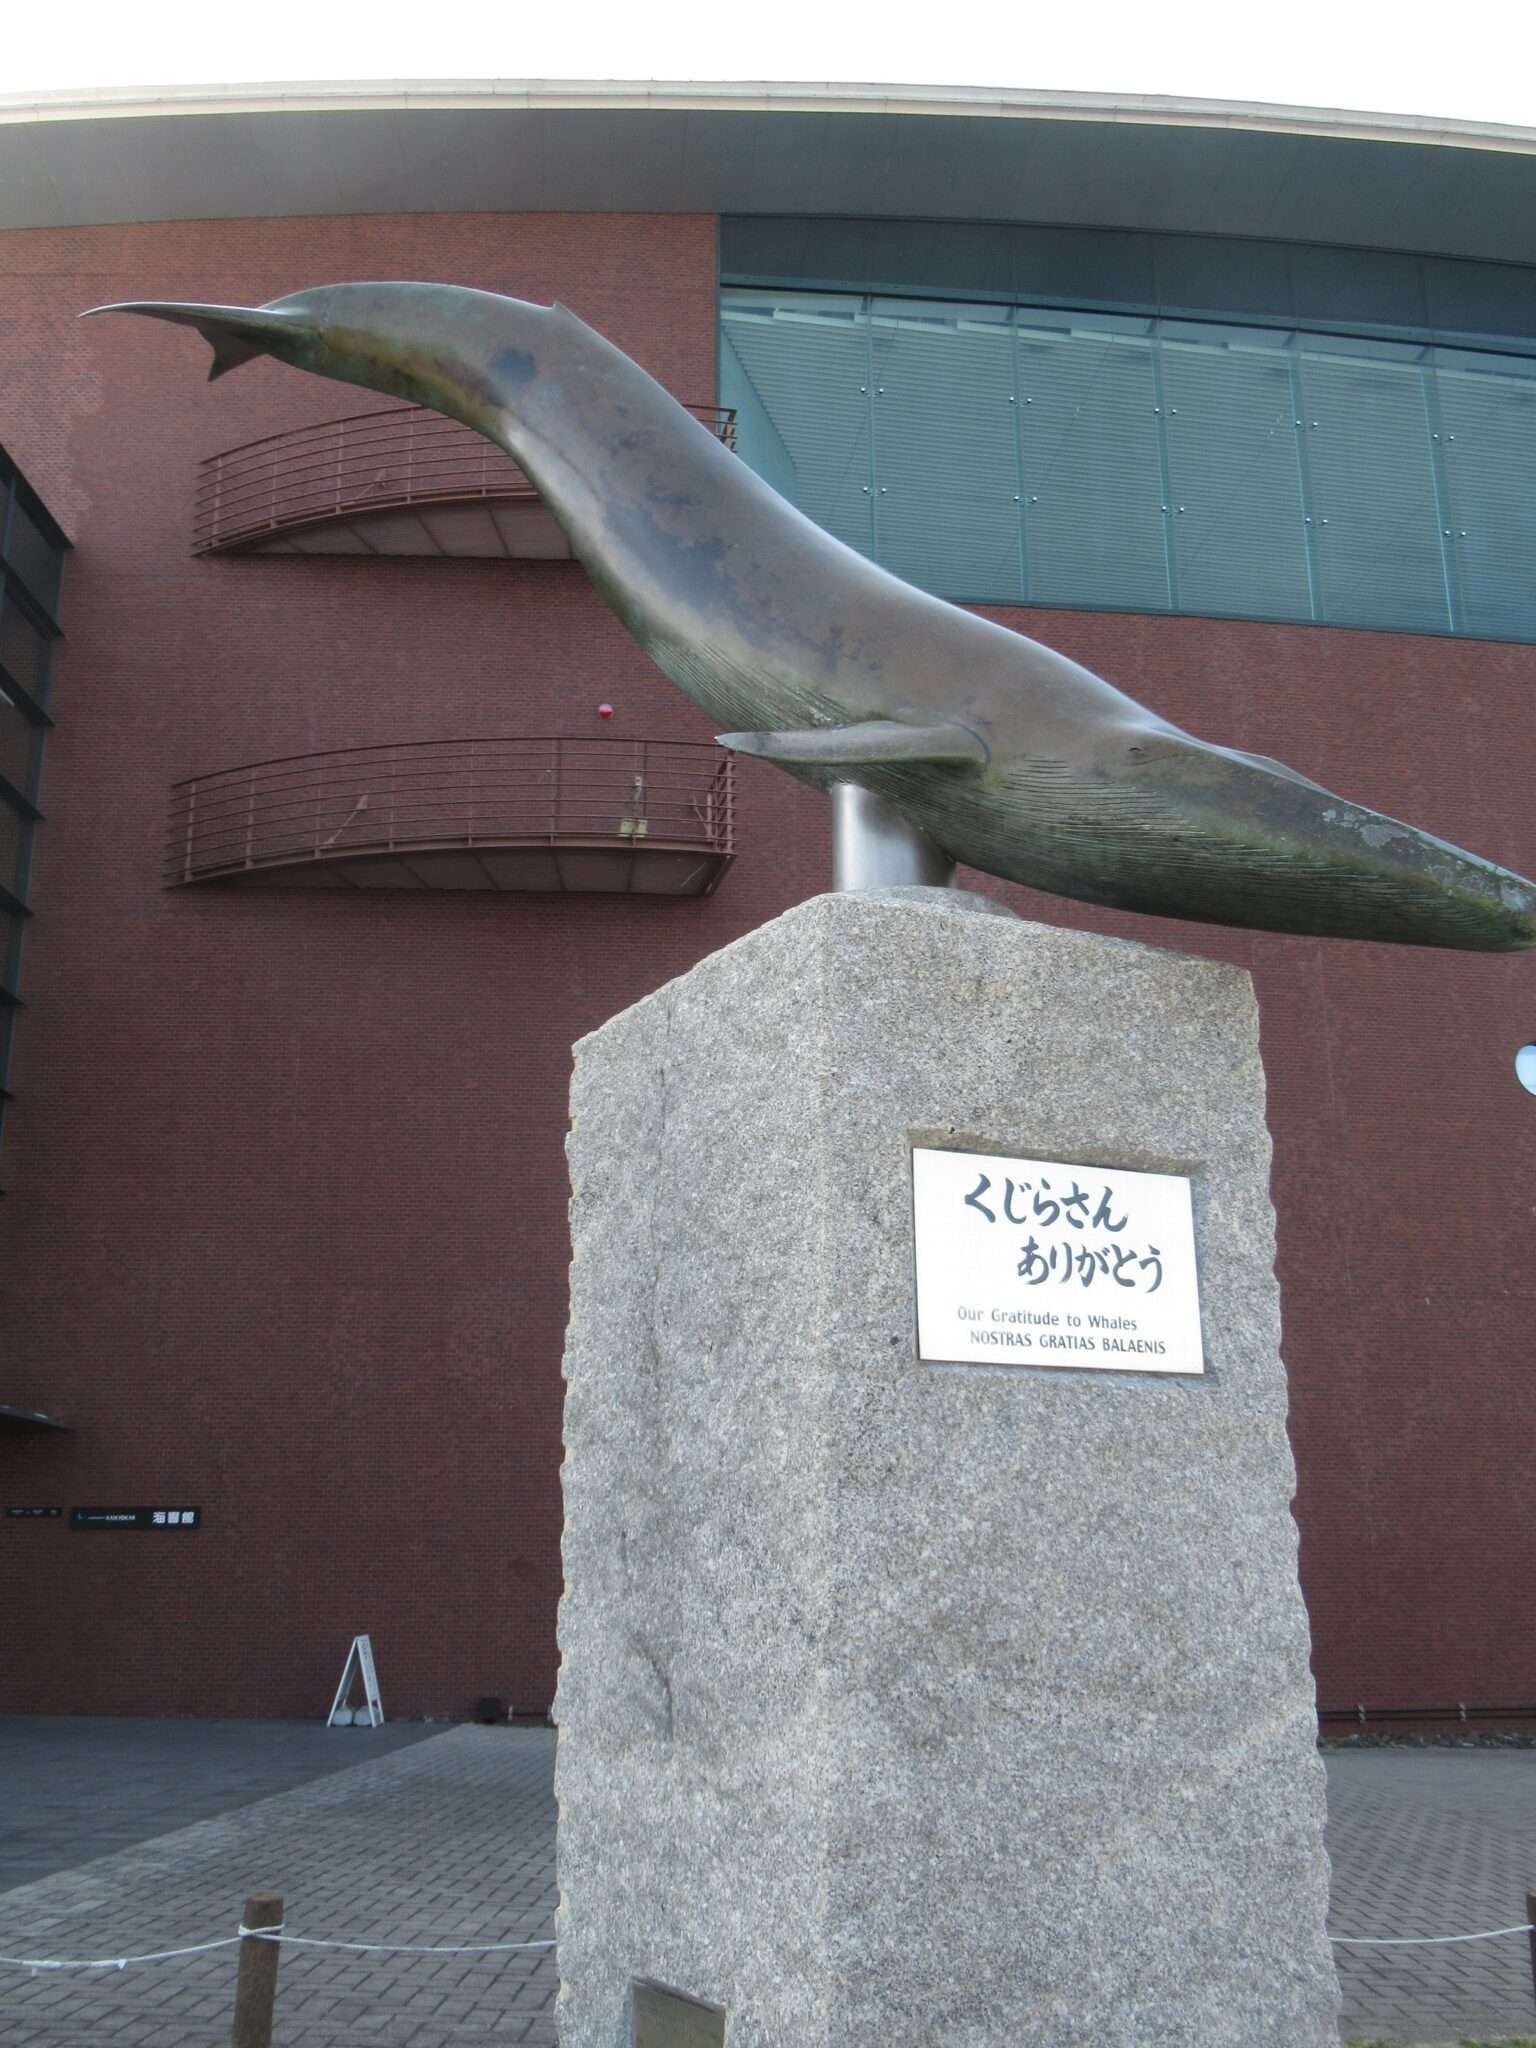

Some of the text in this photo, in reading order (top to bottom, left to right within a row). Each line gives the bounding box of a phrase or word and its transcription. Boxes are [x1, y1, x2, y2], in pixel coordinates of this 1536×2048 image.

[964, 1172, 1128, 1232] くじらさん
[1017, 1235, 1163, 1293] ありがとう
[957, 1306, 1138, 1331] Our Gratitude to Whales
[970, 1330, 1167, 1355] NOSTRAS GRATIAS BALAENIS
